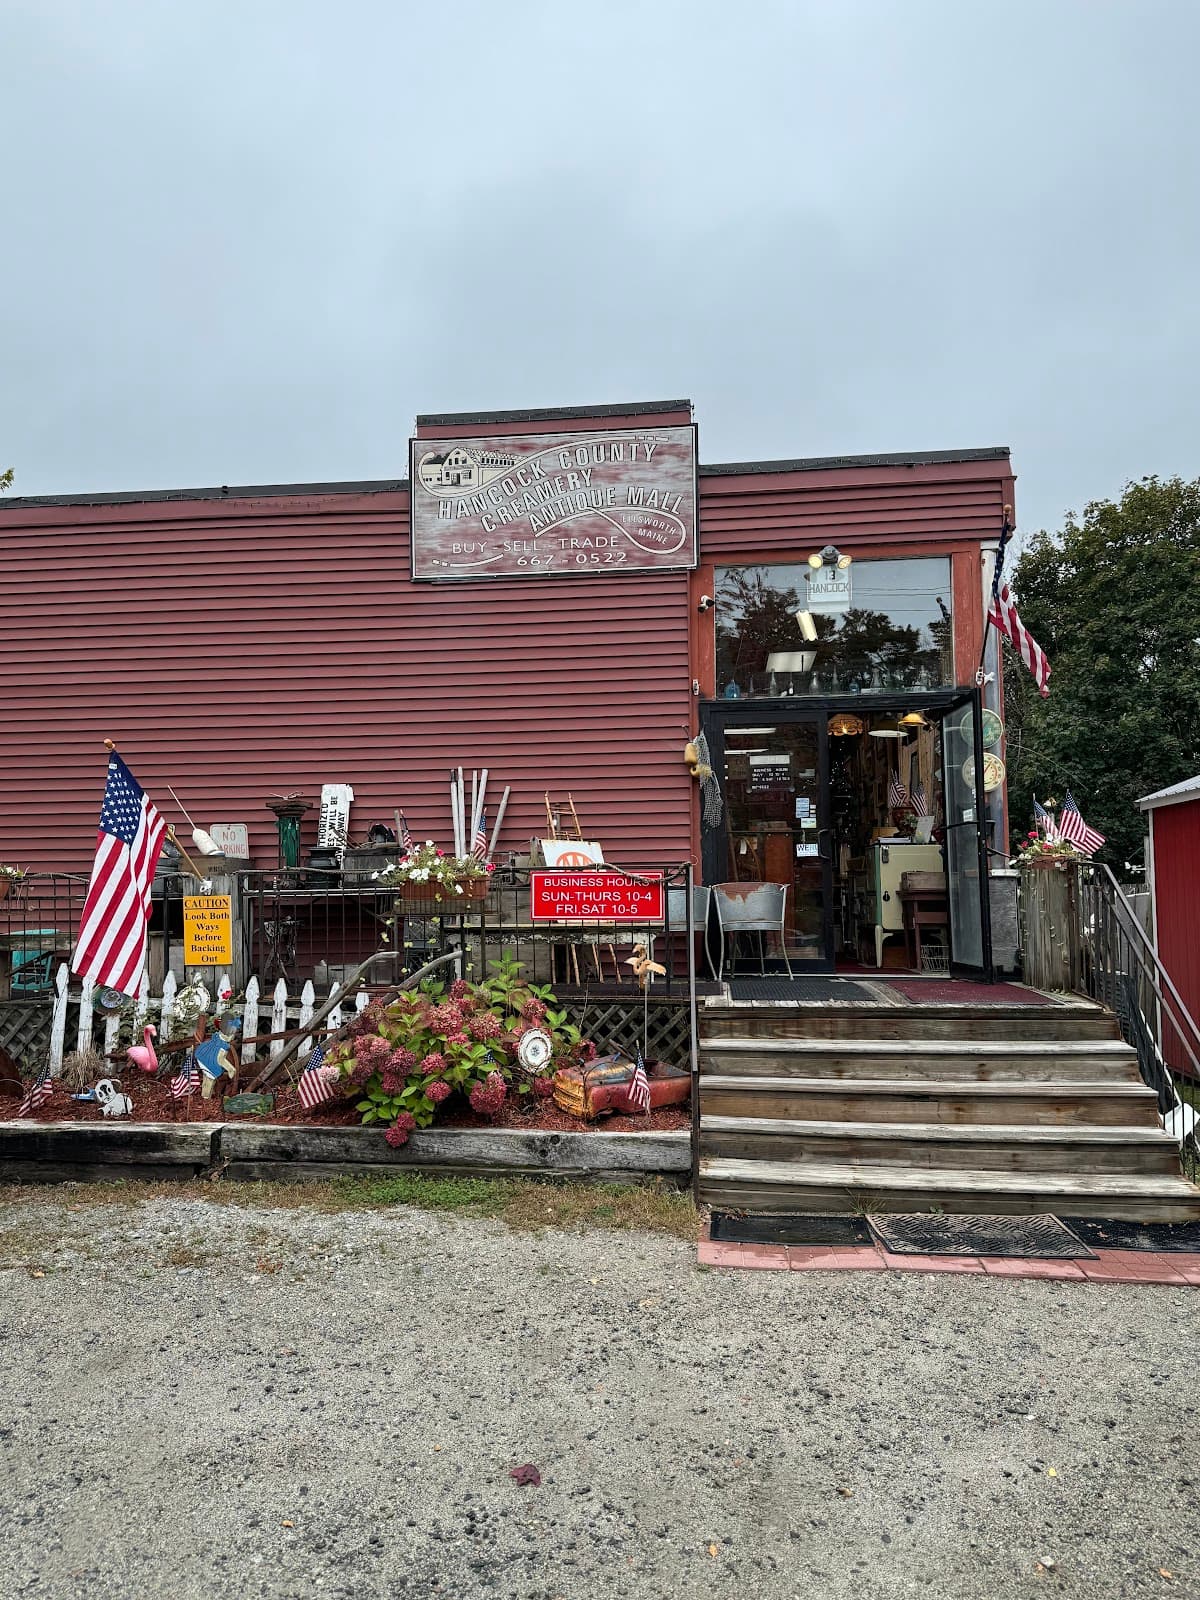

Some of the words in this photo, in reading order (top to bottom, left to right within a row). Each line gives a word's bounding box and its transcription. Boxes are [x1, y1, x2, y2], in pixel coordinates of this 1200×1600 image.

[438, 459, 547, 520] HANCOCK
[559, 443, 658, 470] COUNTY
[481, 468, 594, 533] CREAMERY
[528, 487, 617, 532] ANTIQUE
[628, 486, 684, 516] MALL
[623, 514, 677, 535] ELLSWORTH
[638, 528, 668, 545] MAINE
[452, 541, 488, 554] BUY
[503, 539, 541, 552] SELL
[558, 536, 619, 550] TRADE
[516, 554, 554, 566] 667
[575, 552, 628, 565] 0522
[809, 582, 849, 594] HANCOCK
[331, 796, 338, 806] BE
[319, 803, 329, 848] THORIZED
[329, 809, 337, 830] WILL
[222, 831, 236, 841] NO
[219, 843, 246, 855] RKING
[544, 878, 604, 887] BUSINESS
[606, 878, 650, 887] HOURS
[541, 891, 622, 902] SUN-THURS
[625, 891, 653, 901] 10-4
[184, 899, 229, 908] CAUTION
[611, 904, 638, 914] 10-5
[185, 912, 207, 921] Look
[210, 912, 230, 920] Both
[196, 923, 220, 933] Ways
[191, 944, 226, 953] Backing
[201, 955, 217, 963] Out
